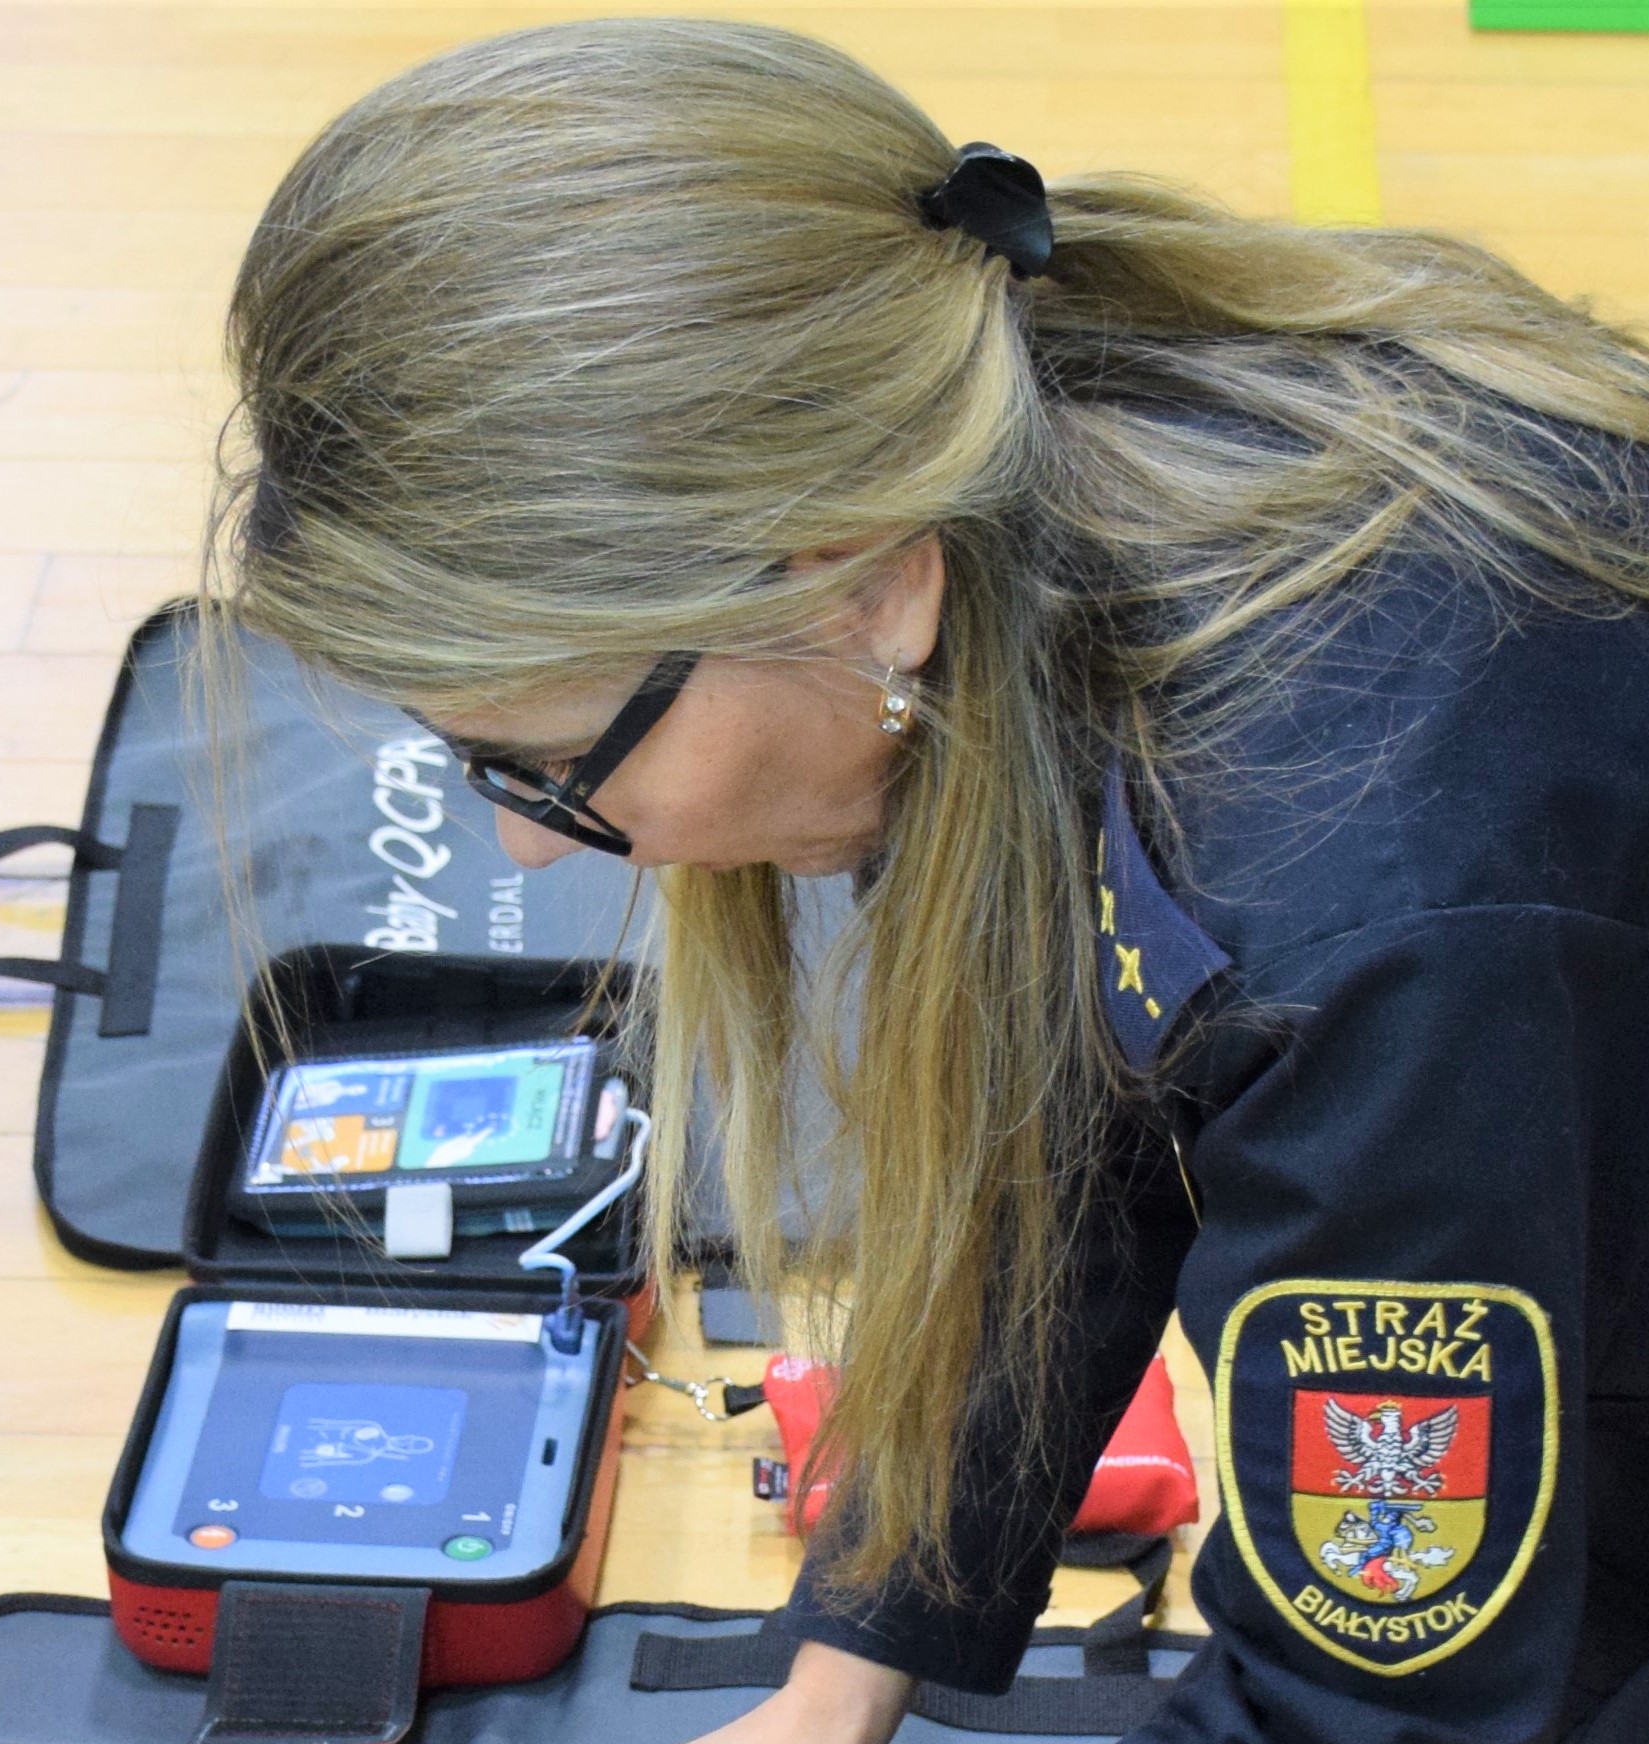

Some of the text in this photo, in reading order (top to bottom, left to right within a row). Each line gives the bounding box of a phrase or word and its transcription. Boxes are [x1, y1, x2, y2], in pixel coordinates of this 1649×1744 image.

[488, 872, 524, 954] ERDAL
[1299, 1298, 1489, 1341] STRAŻ
[1280, 1336, 1492, 1382] MIEJSKA
[208, 1499, 239, 1511] 3
[334, 1504, 366, 1518] 2
[462, 1511, 492, 1522] 1
[1292, 1584, 1480, 1643] BIAŁYSTOK
